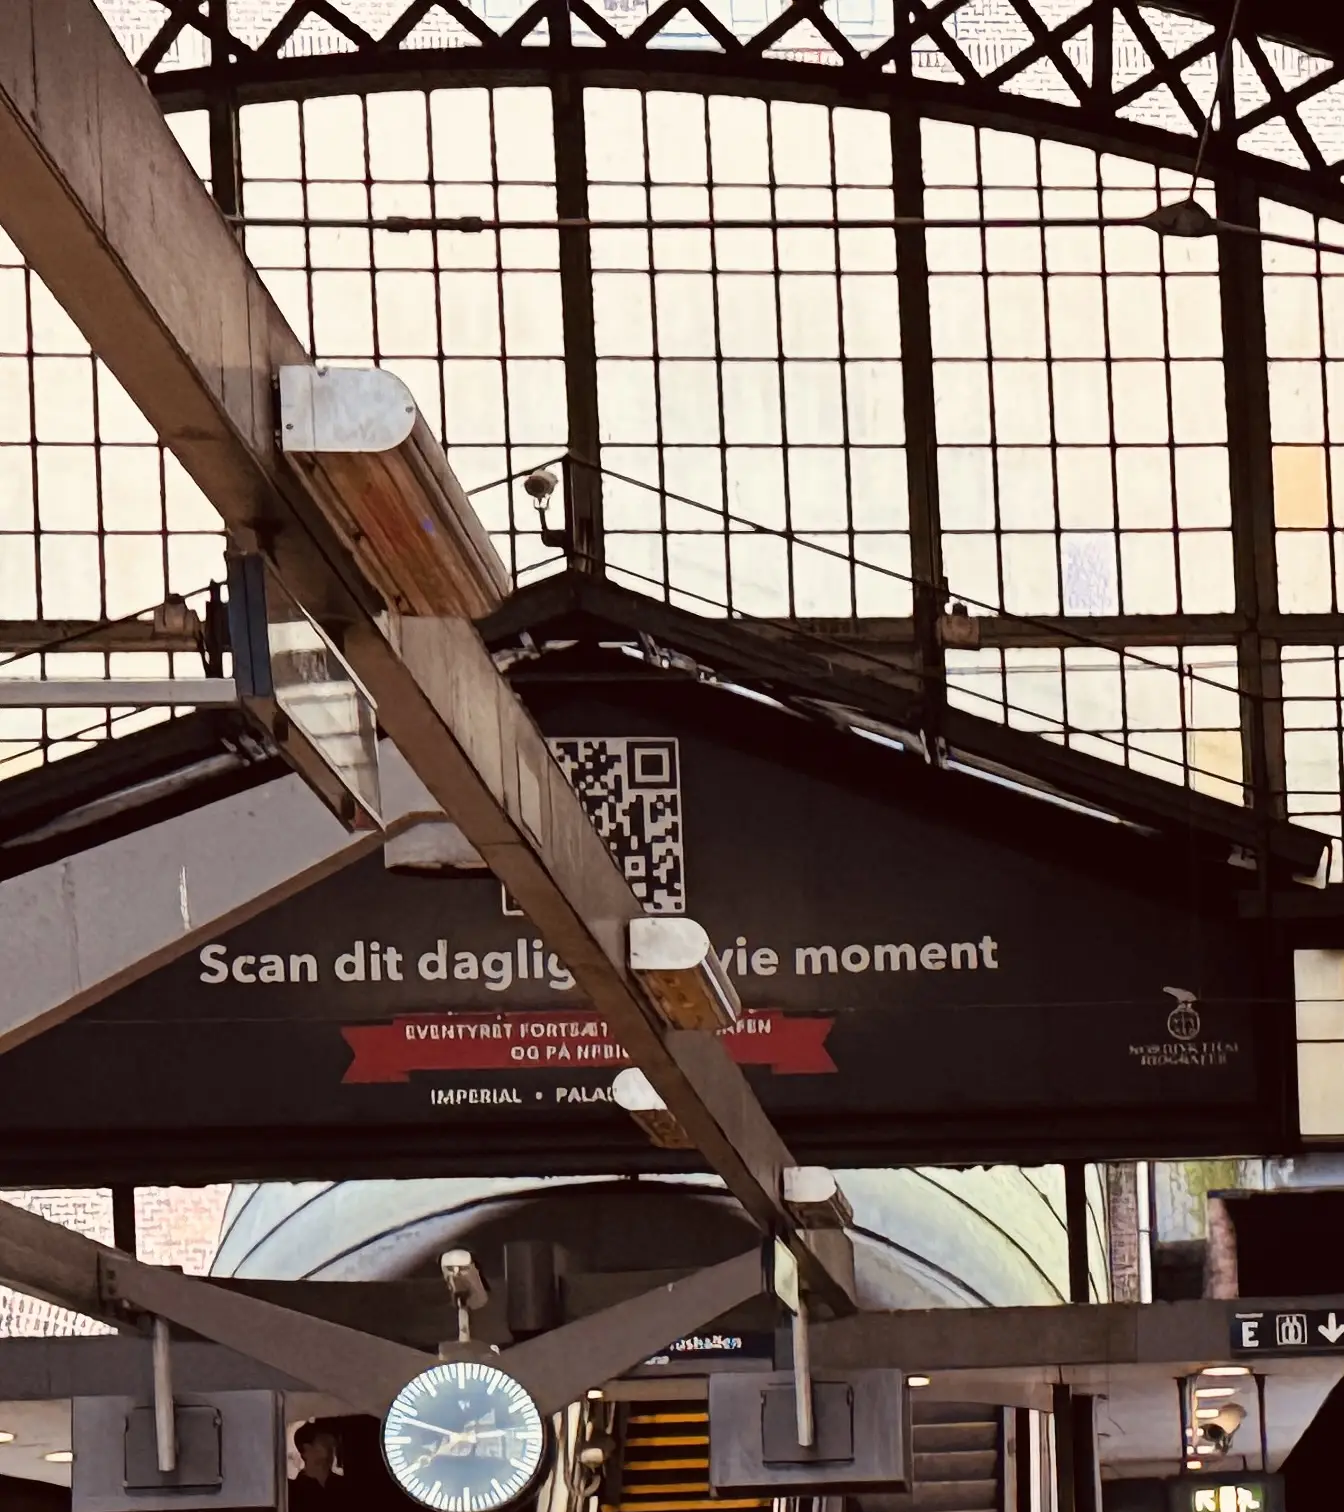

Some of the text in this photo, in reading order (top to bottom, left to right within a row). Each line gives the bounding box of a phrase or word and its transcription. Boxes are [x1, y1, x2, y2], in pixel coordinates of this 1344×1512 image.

[199, 943, 319, 984] Scan
[334, 940, 404, 983] dit
[795, 935, 1000, 976] moment
[545, 1041, 571, 1061] PÅ
[430, 1088, 523, 1105] IMPERIAL
[1242, 1321, 1260, 1348] E
